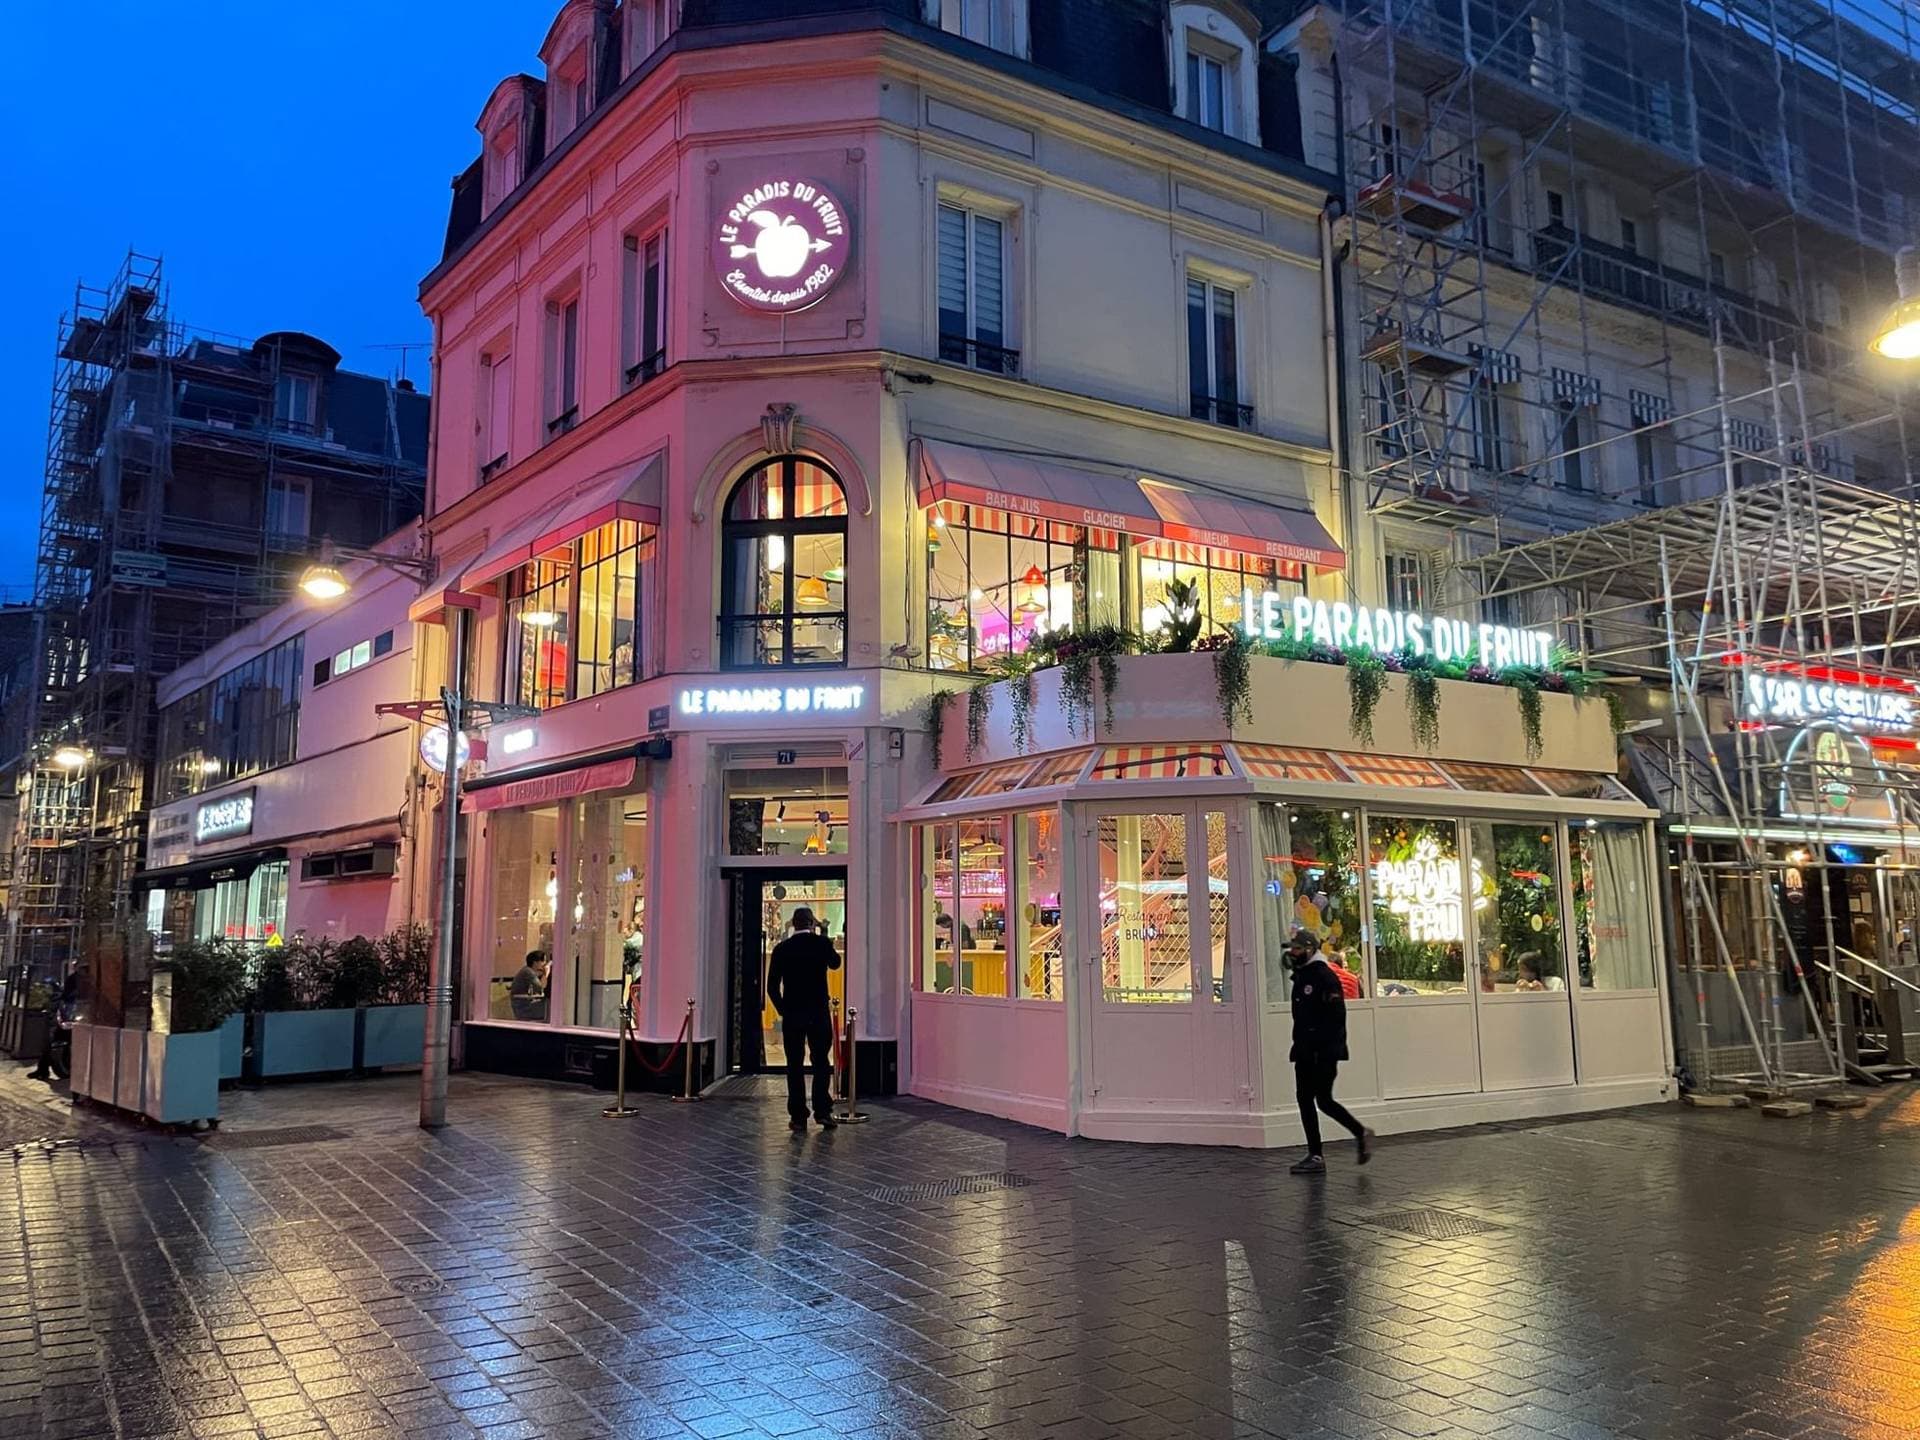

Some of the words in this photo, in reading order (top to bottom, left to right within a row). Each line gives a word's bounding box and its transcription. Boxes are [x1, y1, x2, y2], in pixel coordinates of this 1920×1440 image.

[720, 224, 738, 243] LE
[729, 181, 790, 223] PARADIS
[793, 182, 816, 202] DU
[813, 194, 843, 236] FRUIT
[771, 288, 807, 305] depuis
[804, 263, 835, 293] 1982
[985, 492, 1008, 507] BAR
[1020, 499, 1040, 514] JUS
[1083, 509, 1126, 529] GLACIER
[1266, 542, 1321, 563] RESTAURANT
[1243, 588, 1281, 639] LE
[1293, 596, 1425, 657] PARADIS
[1431, 616, 1470, 661] DU
[1478, 623, 1553, 668] FRUIT
[681, 690, 704, 714] LE
[706, 688, 782, 713] PARADIS
[785, 687, 810, 711] DU
[814, 685, 864, 710] FRUIT
[779, 752, 791, 763] 71
